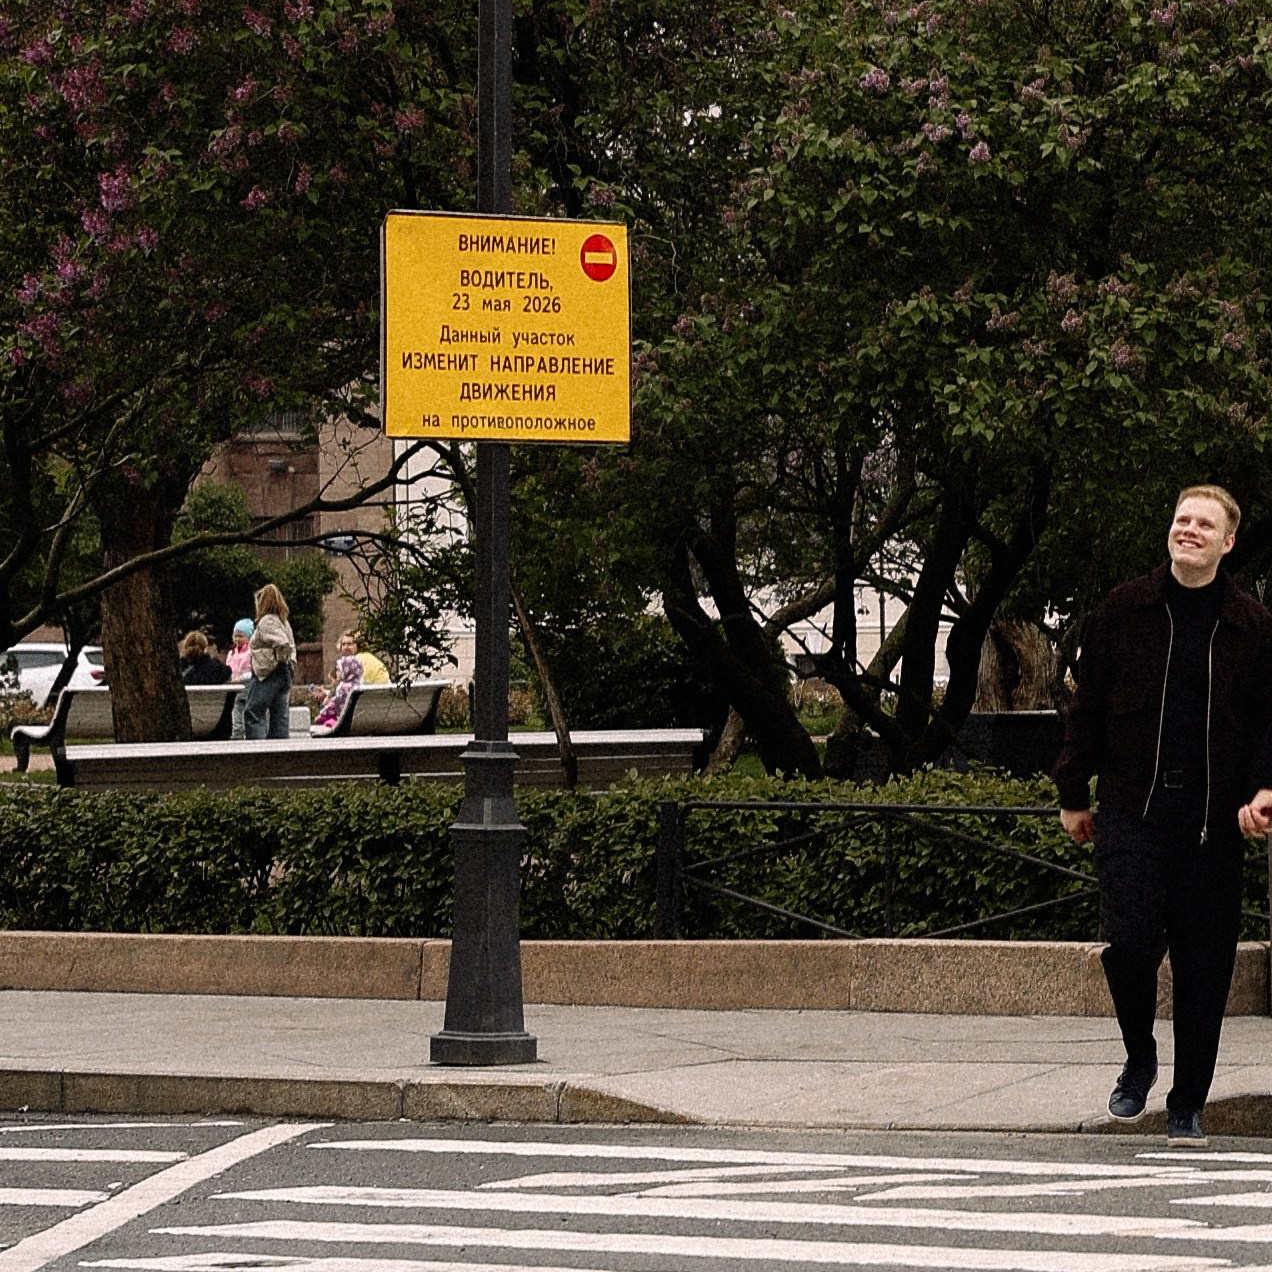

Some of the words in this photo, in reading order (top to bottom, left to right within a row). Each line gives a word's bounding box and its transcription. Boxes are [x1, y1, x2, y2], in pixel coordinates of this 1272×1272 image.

[459, 235, 555, 255] ВНИМАНИЕ!
[460, 270, 553, 291] ВОДИТЕЛЬ,
[453, 294, 470, 311] 23
[483, 300, 511, 311] мая
[523, 296, 561, 313] 2026
[440, 326, 501, 344] Данный
[513, 332, 575, 348] участок
[402, 353, 478, 371] ИЗМЕНИТ
[490, 356, 614, 375] НАПРАВЛЕНИЕ
[460, 383, 555, 401] ДВИЖЕНИЯ
[423, 415, 440, 427] на
[452, 415, 595, 431] противоположное
